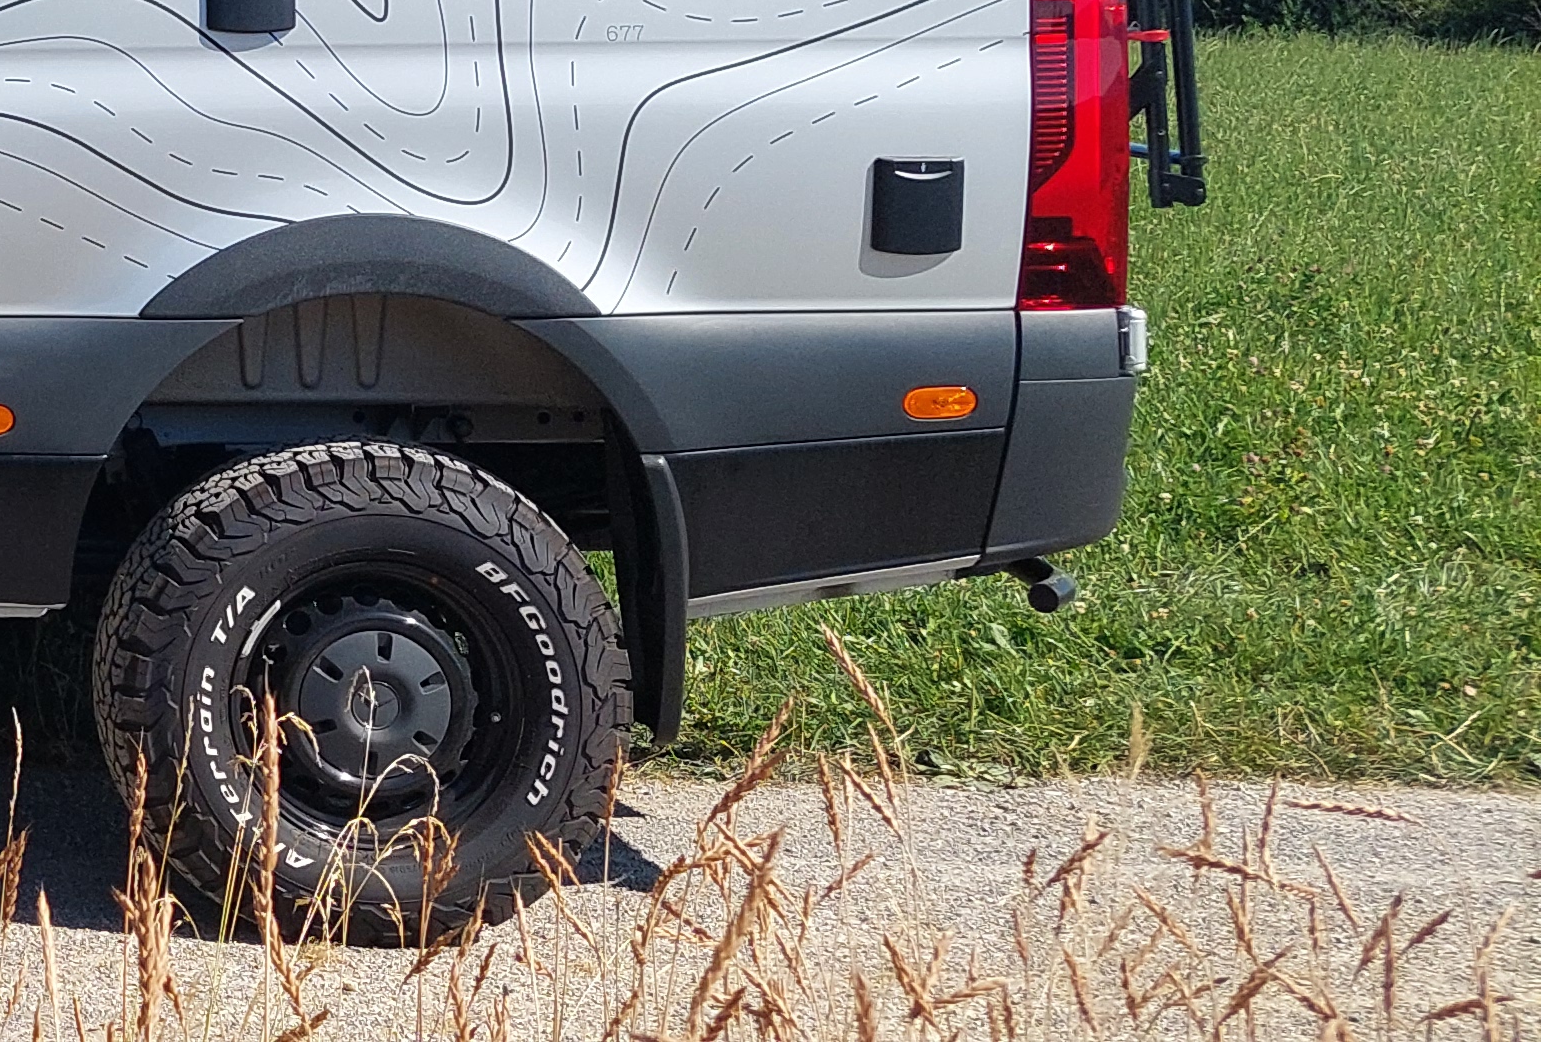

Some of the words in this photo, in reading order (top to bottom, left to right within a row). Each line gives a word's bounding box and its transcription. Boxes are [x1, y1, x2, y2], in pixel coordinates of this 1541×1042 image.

[606, 24, 644, 42] 677
[210, 585, 256, 645] T/A
[475, 561, 569, 806] BFGoodrich
